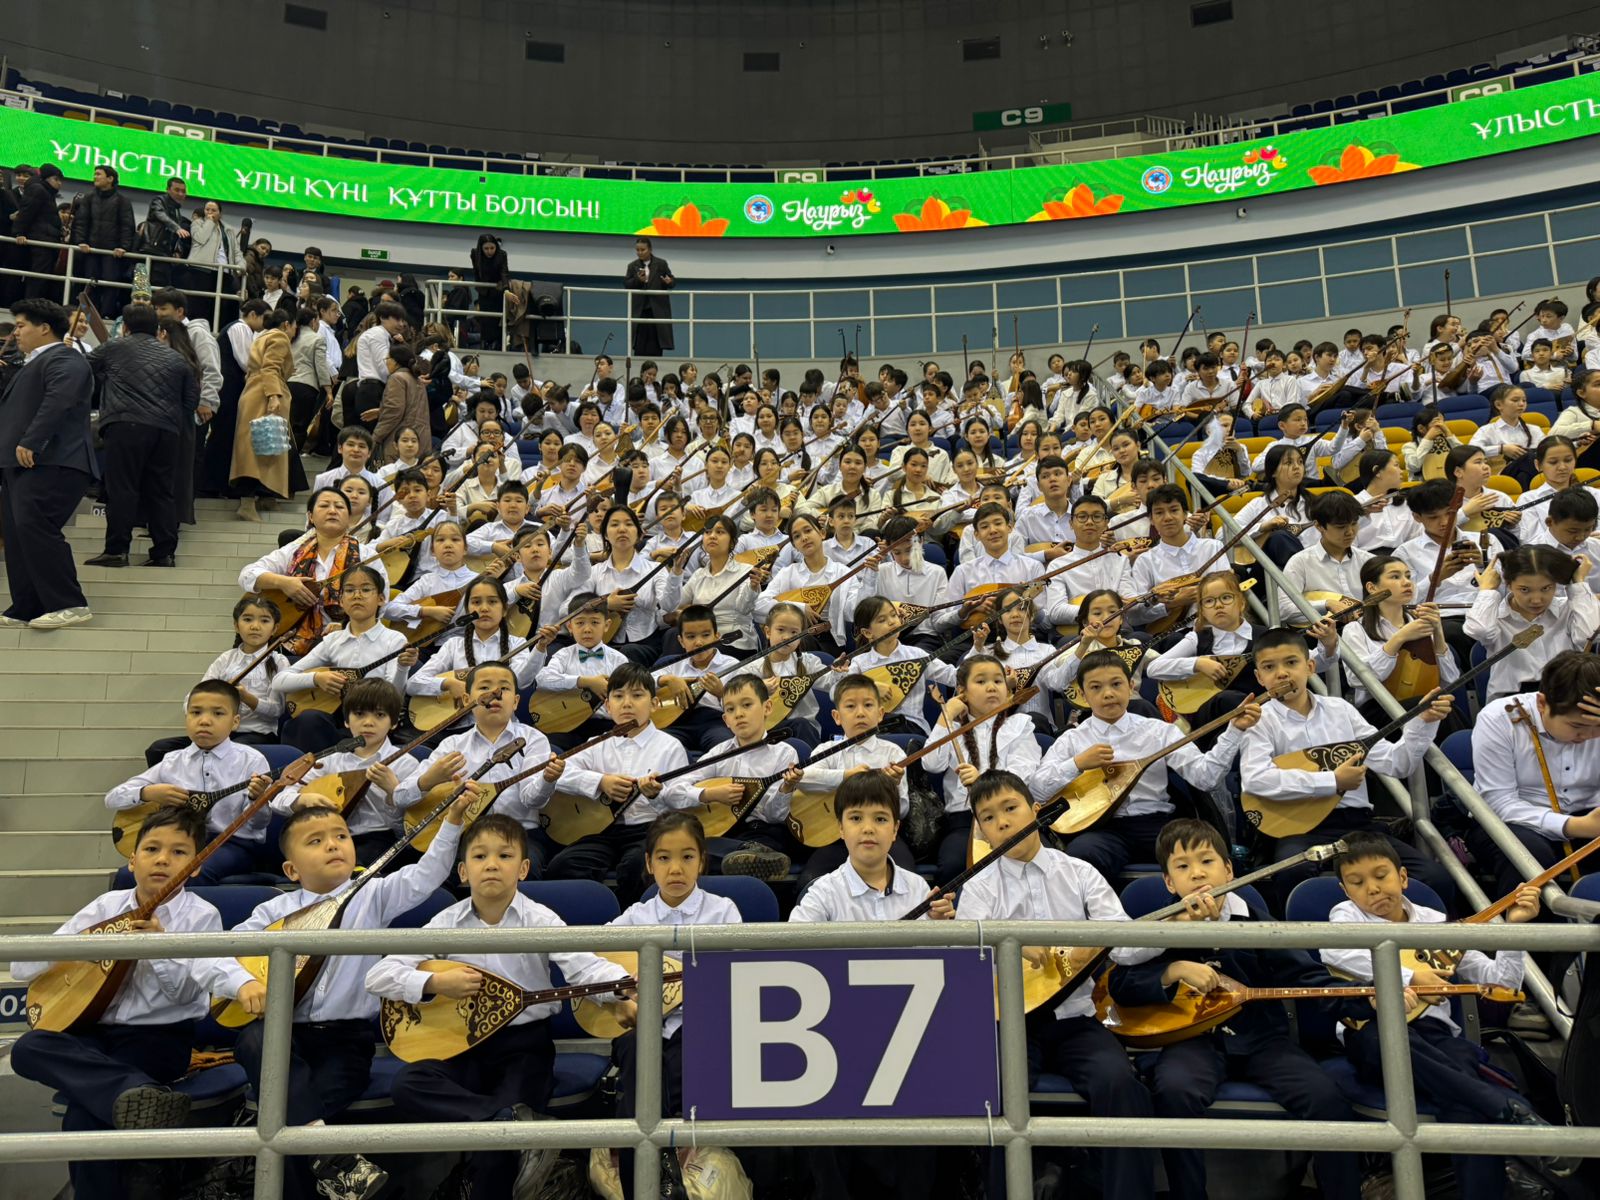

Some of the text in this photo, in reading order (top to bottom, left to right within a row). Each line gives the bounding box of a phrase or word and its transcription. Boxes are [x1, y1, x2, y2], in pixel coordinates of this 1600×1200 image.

[1001, 107, 1043, 126] C9
[50, 139, 600, 219] ҰЛЫСТЫҢ ҰЛЫ КҮНІ ҚҰТТЫ БОЛСЫН!
[1181, 162, 1279, 194] Наурыз
[782, 197, 873, 231] Наурыз
[731, 959, 945, 1108] B7
